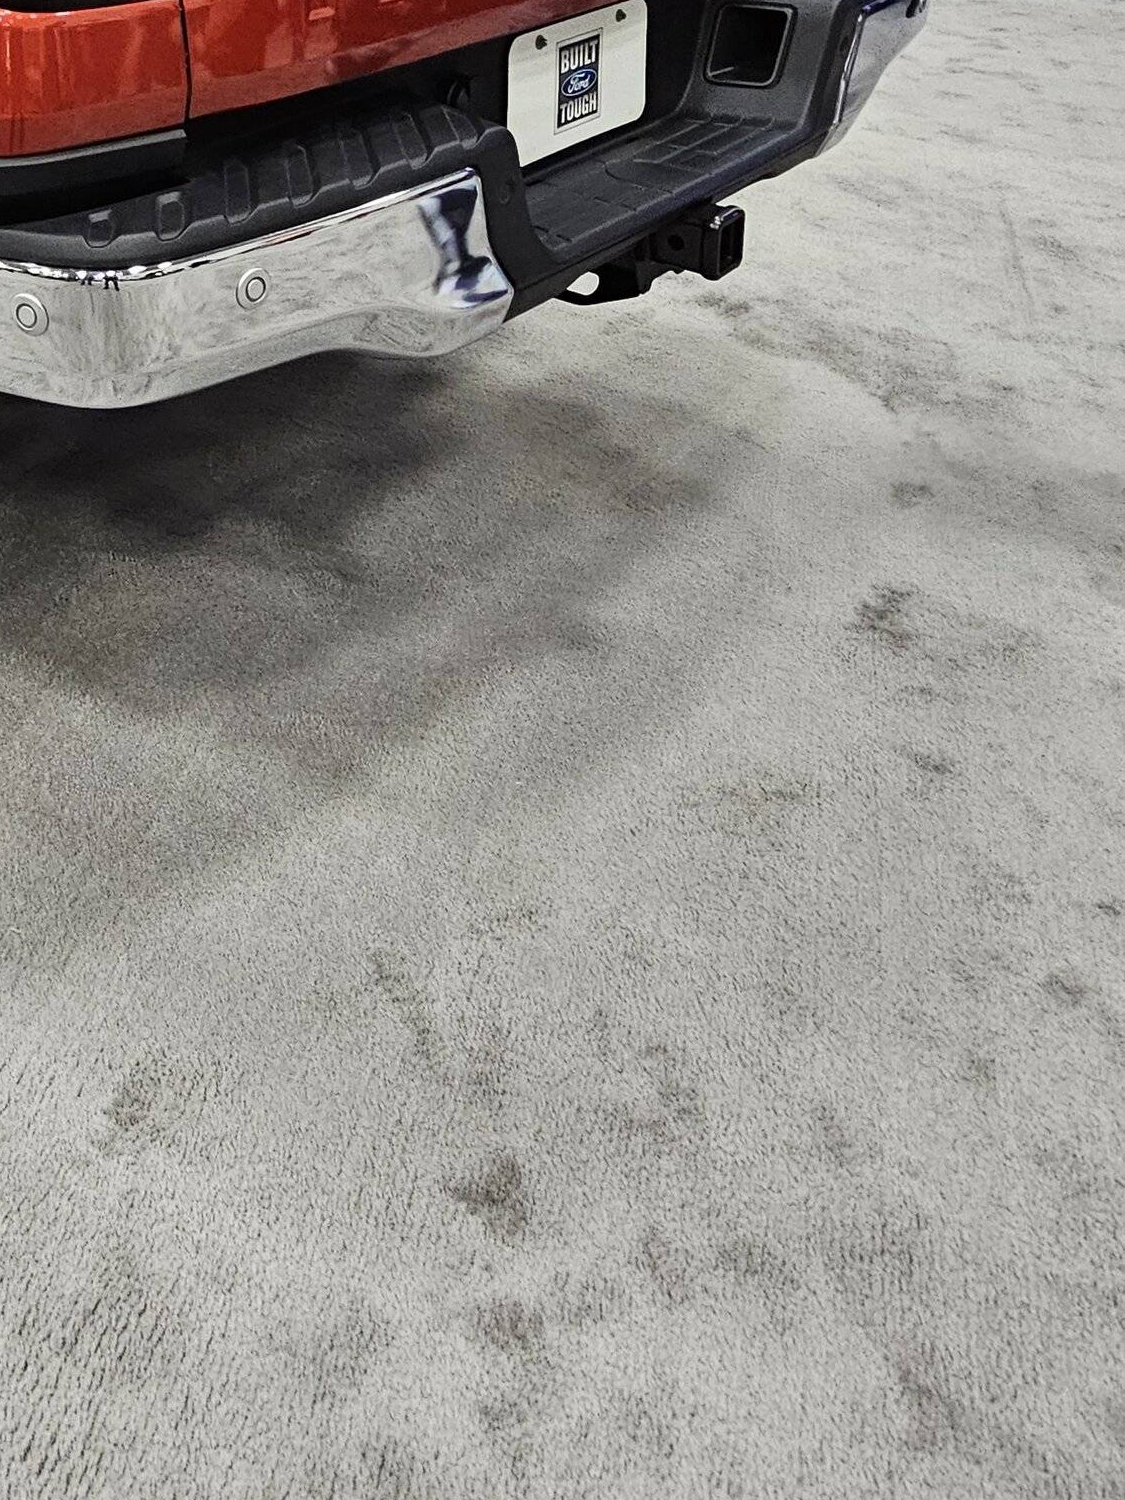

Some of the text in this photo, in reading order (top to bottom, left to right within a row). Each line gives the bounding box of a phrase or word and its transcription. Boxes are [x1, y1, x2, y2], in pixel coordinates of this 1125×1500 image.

[561, 39, 598, 74] BUILT
[567, 74, 592, 94] Ford
[560, 91, 597, 124] TOUGH
